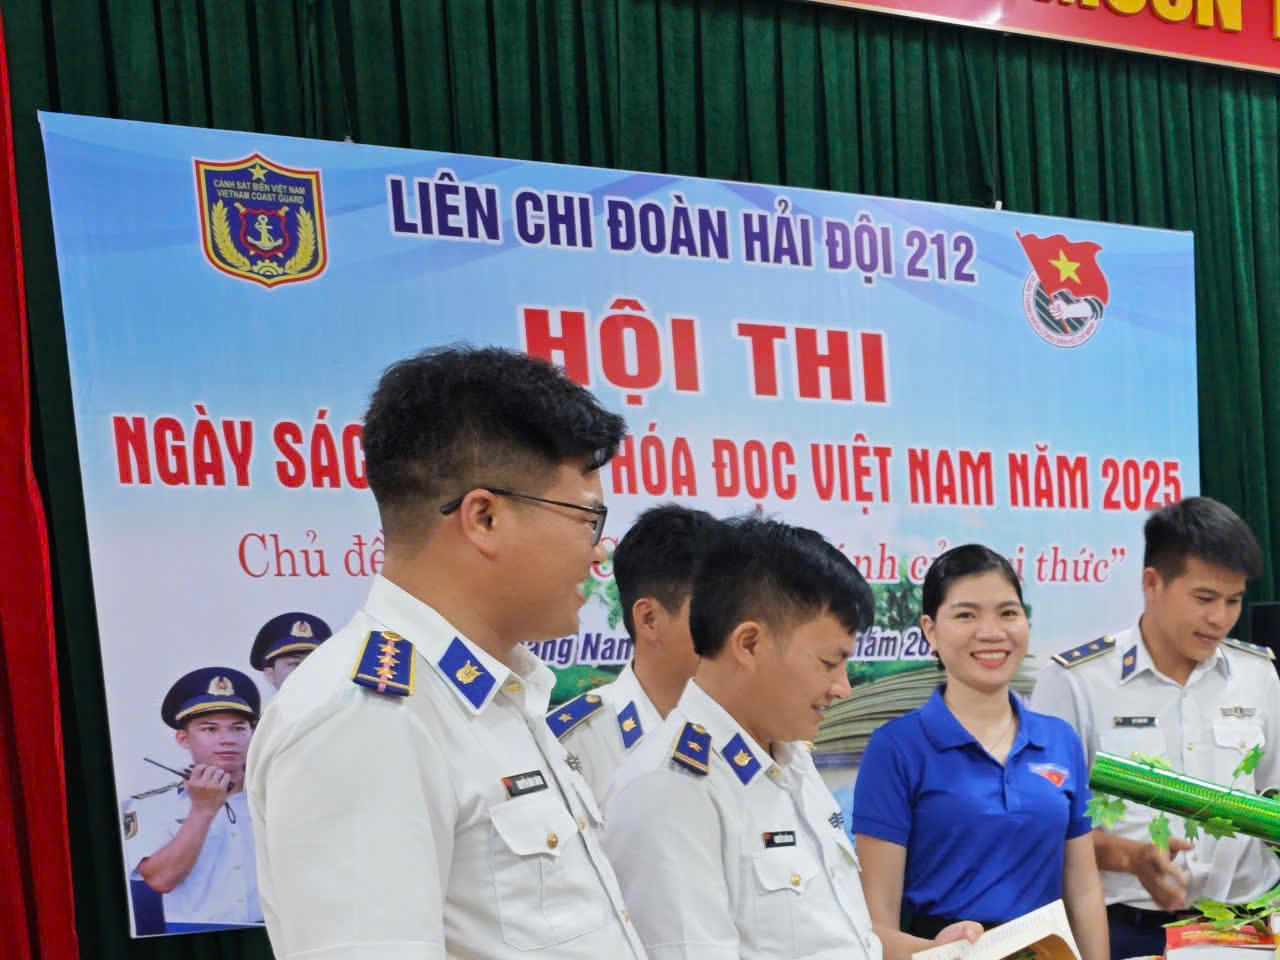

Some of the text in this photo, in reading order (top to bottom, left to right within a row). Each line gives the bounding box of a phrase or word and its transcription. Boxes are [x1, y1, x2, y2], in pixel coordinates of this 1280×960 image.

[217, 189, 304, 204] VIETNAM COAST GUARD
[289, 186, 305, 195] NAM
[390, 172, 976, 284] LIÊN CHI ĐOÀN HẢI ĐỘI 212
[524, 298, 887, 405] HỘI THI
[113, 404, 253, 487] NGÀY
[273, 409, 372, 489] SÁC
[712, 438, 797, 512] ĐỌC
[810, 433, 892, 515] VIỆT
[908, 448, 994, 506] NAM
[1008, 444, 1089, 509] NĂM
[1101, 458, 1182, 511] 2025
[238, 529, 329, 578] Chủ
